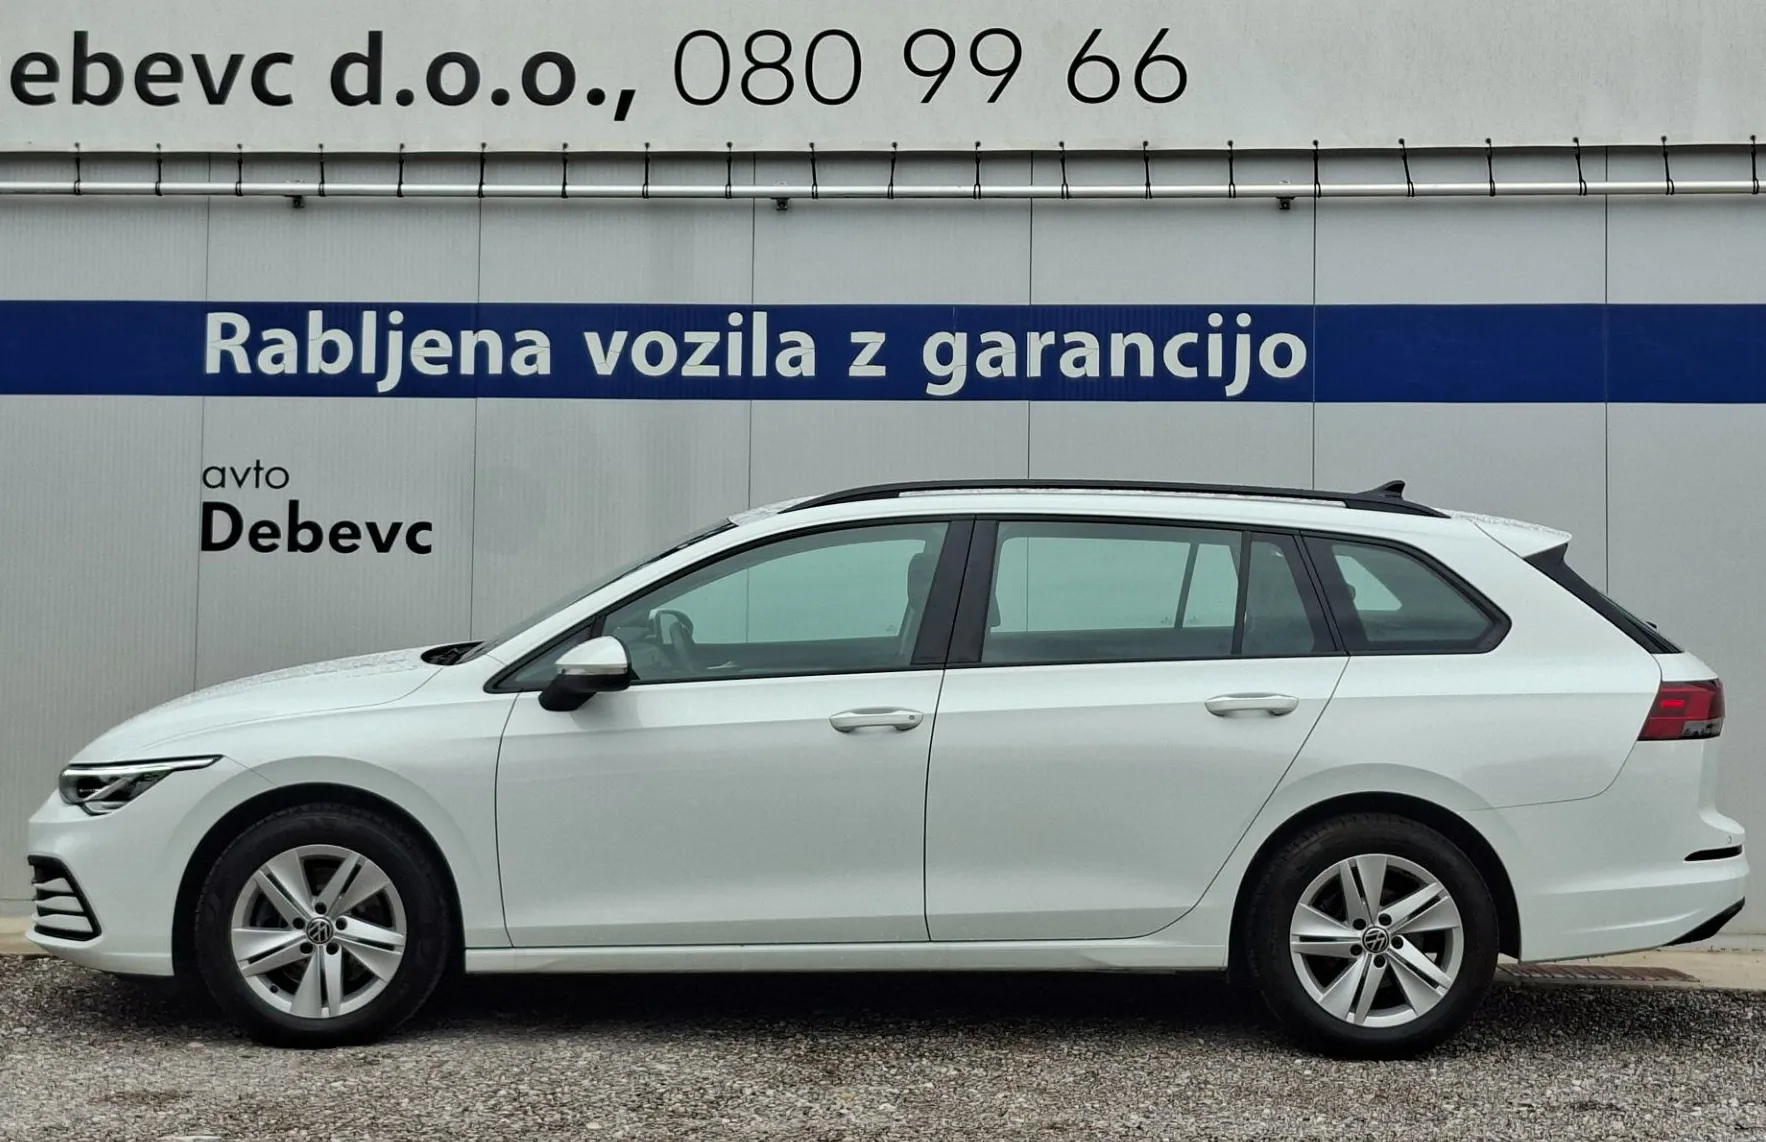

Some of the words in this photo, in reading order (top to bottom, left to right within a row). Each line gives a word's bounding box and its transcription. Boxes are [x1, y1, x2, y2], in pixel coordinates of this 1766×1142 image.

[9, 31, 295, 107] ebevc
[329, 30, 637, 122] d.o.o.,
[673, 29, 863, 106] 080
[903, 28, 1023, 104] 99
[1066, 27, 1188, 105] 66
[205, 309, 551, 393] Rabljena
[583, 311, 816, 378] vozila
[848, 331, 886, 377] z
[922, 312, 1307, 397] garancijo
[202, 459, 290, 489] avto
[200, 499, 433, 555] Debevc
